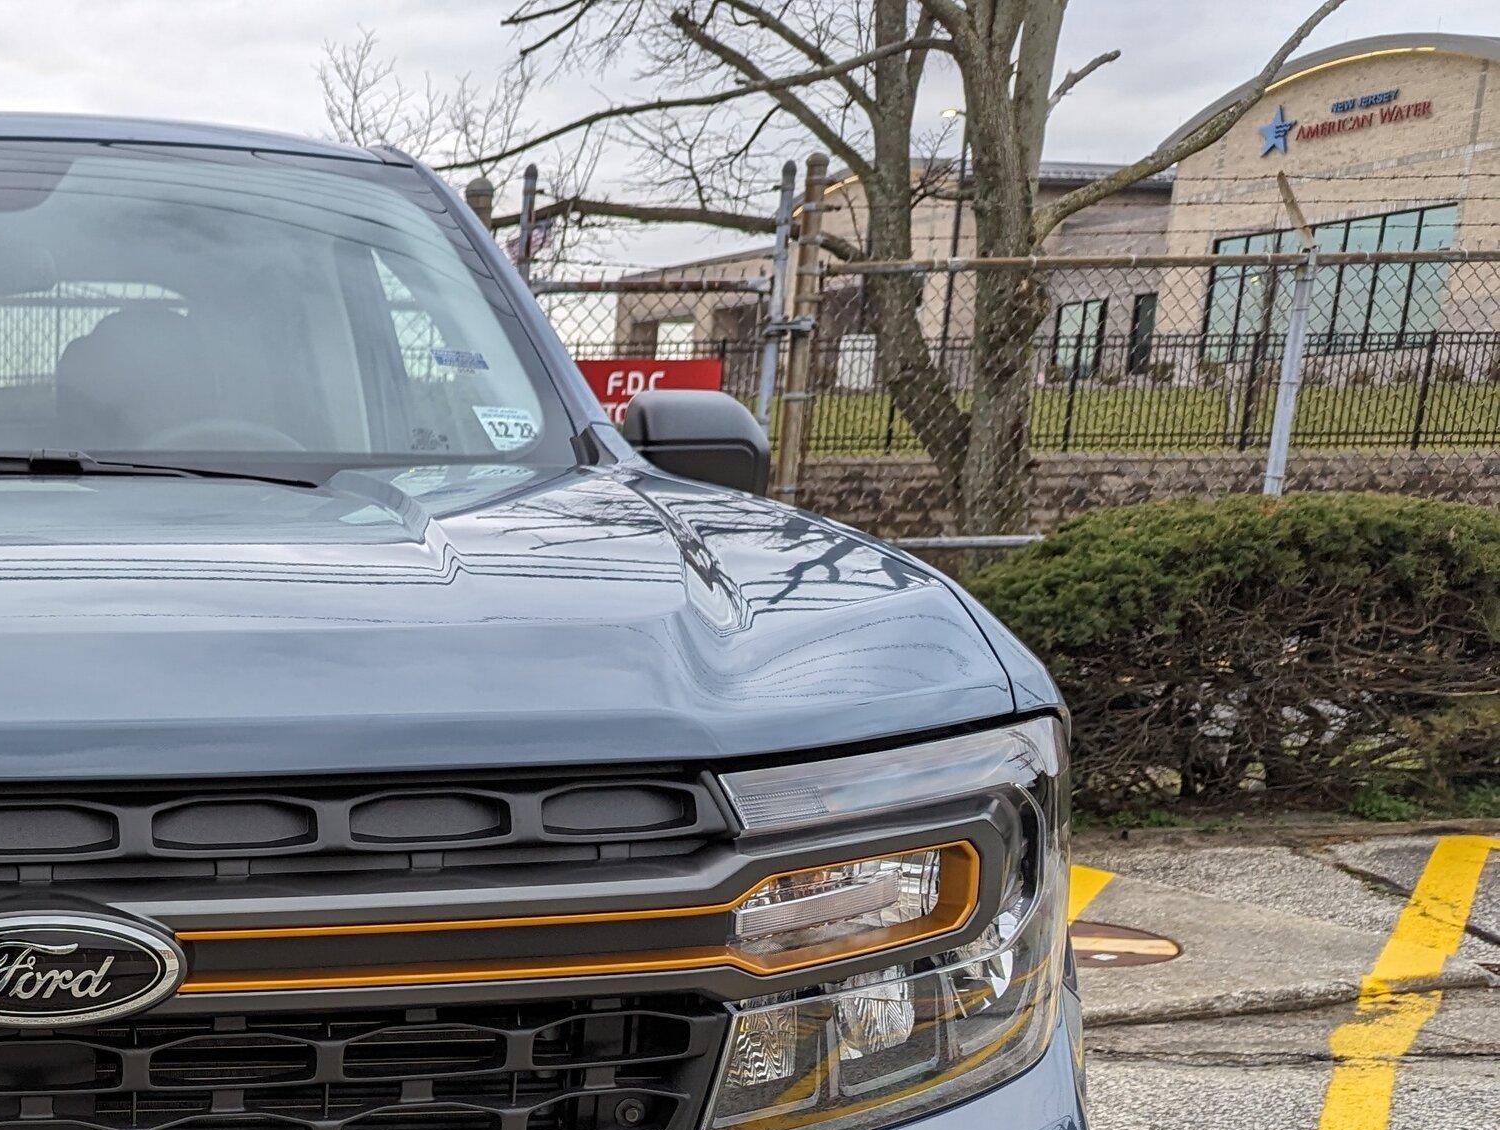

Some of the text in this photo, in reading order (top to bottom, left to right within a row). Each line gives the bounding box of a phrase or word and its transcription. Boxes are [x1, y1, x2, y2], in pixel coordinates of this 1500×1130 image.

[1331, 88, 1400, 113] NEW JERSEY
[1295, 101, 1433, 141] AMERICAN WATER
[487, 421, 514, 438] 12
